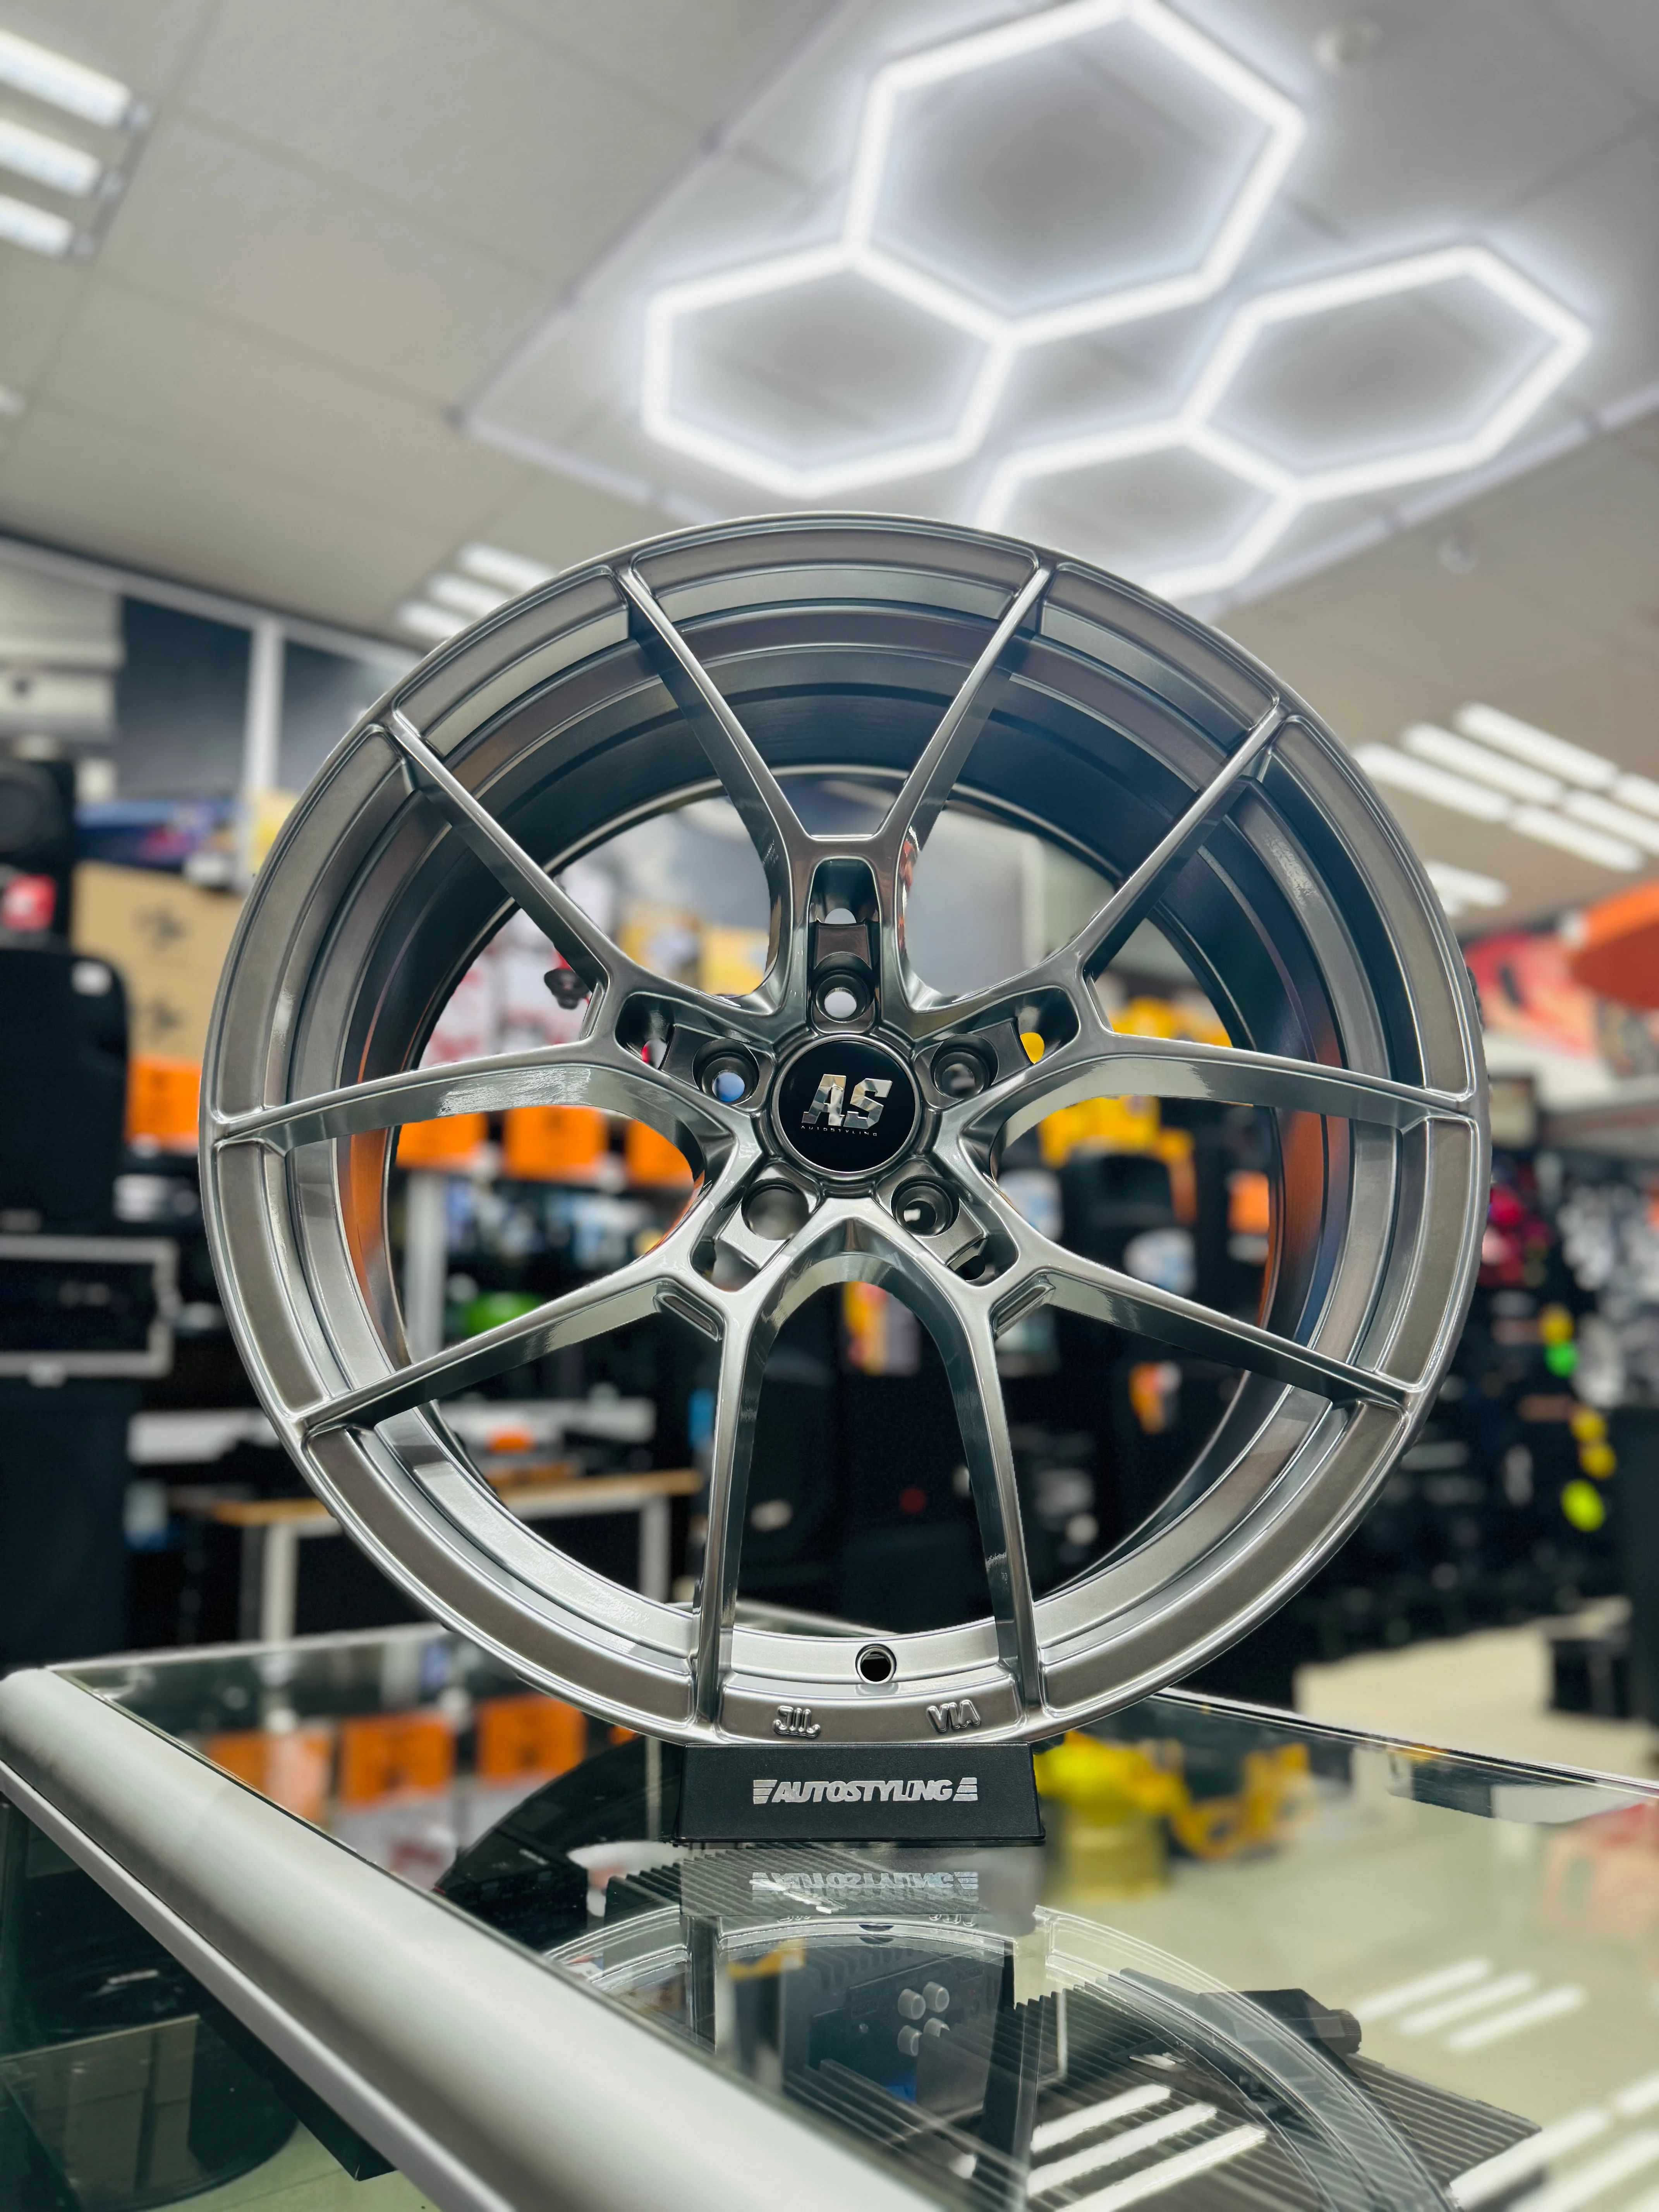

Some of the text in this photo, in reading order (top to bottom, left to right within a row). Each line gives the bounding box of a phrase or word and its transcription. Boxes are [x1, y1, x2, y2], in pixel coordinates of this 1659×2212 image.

[802, 1074, 892, 1129] AS
[801, 1125, 877, 1136] AUTOSTYLING
[927, 1699, 980, 1732] VIA
[771, 1779, 953, 1803] AUTOSTYLING
